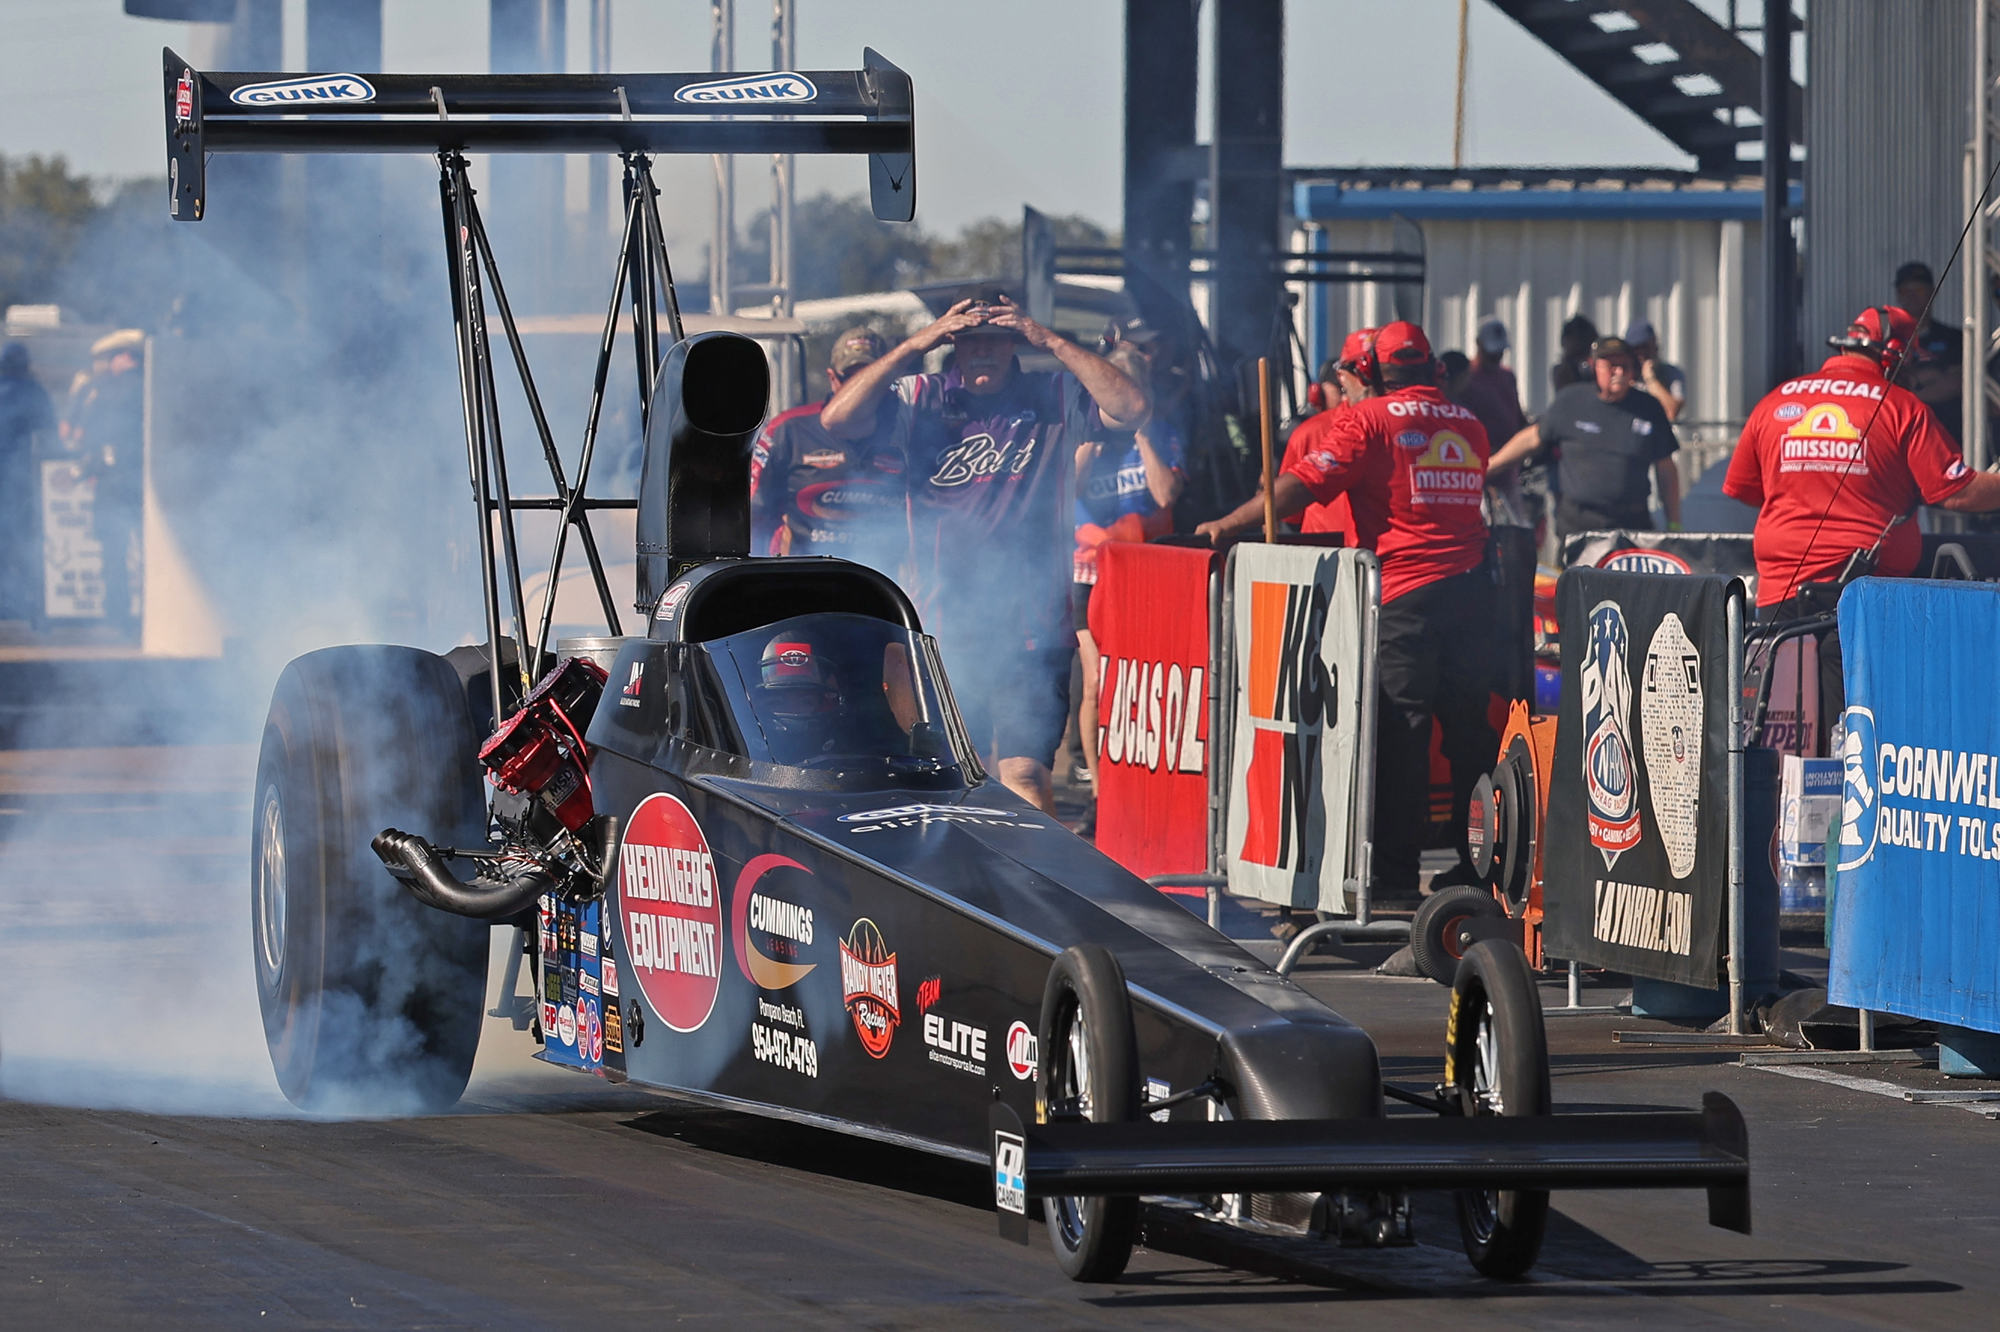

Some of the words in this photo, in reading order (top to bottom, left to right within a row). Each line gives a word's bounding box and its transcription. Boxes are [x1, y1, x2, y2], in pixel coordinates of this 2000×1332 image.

[249, 84, 359, 102] GUNK
[693, 82, 800, 101] GUNK
[170, 157, 179, 215] 2
[1781, 378, 1884, 400] OFFICIAL
[1785, 438, 1863, 459] MISSION
[1880, 806, 1952, 853] QUALTY
[622, 842, 713, 909] HEDINGER'S
[750, 893, 814, 946] CUMMINGS
[629, 911, 718, 979] EQUIPMENT
[841, 949, 869, 997] RANDY
[869, 963, 899, 1012] MEYER
[917, 977, 942, 1016] TEAM
[758, 997, 782, 1023] Pompano
[858, 1002, 887, 1036] Racing
[751, 1021, 819, 1079] 954-973-4759
[924, 1012, 987, 1062] ELITE
